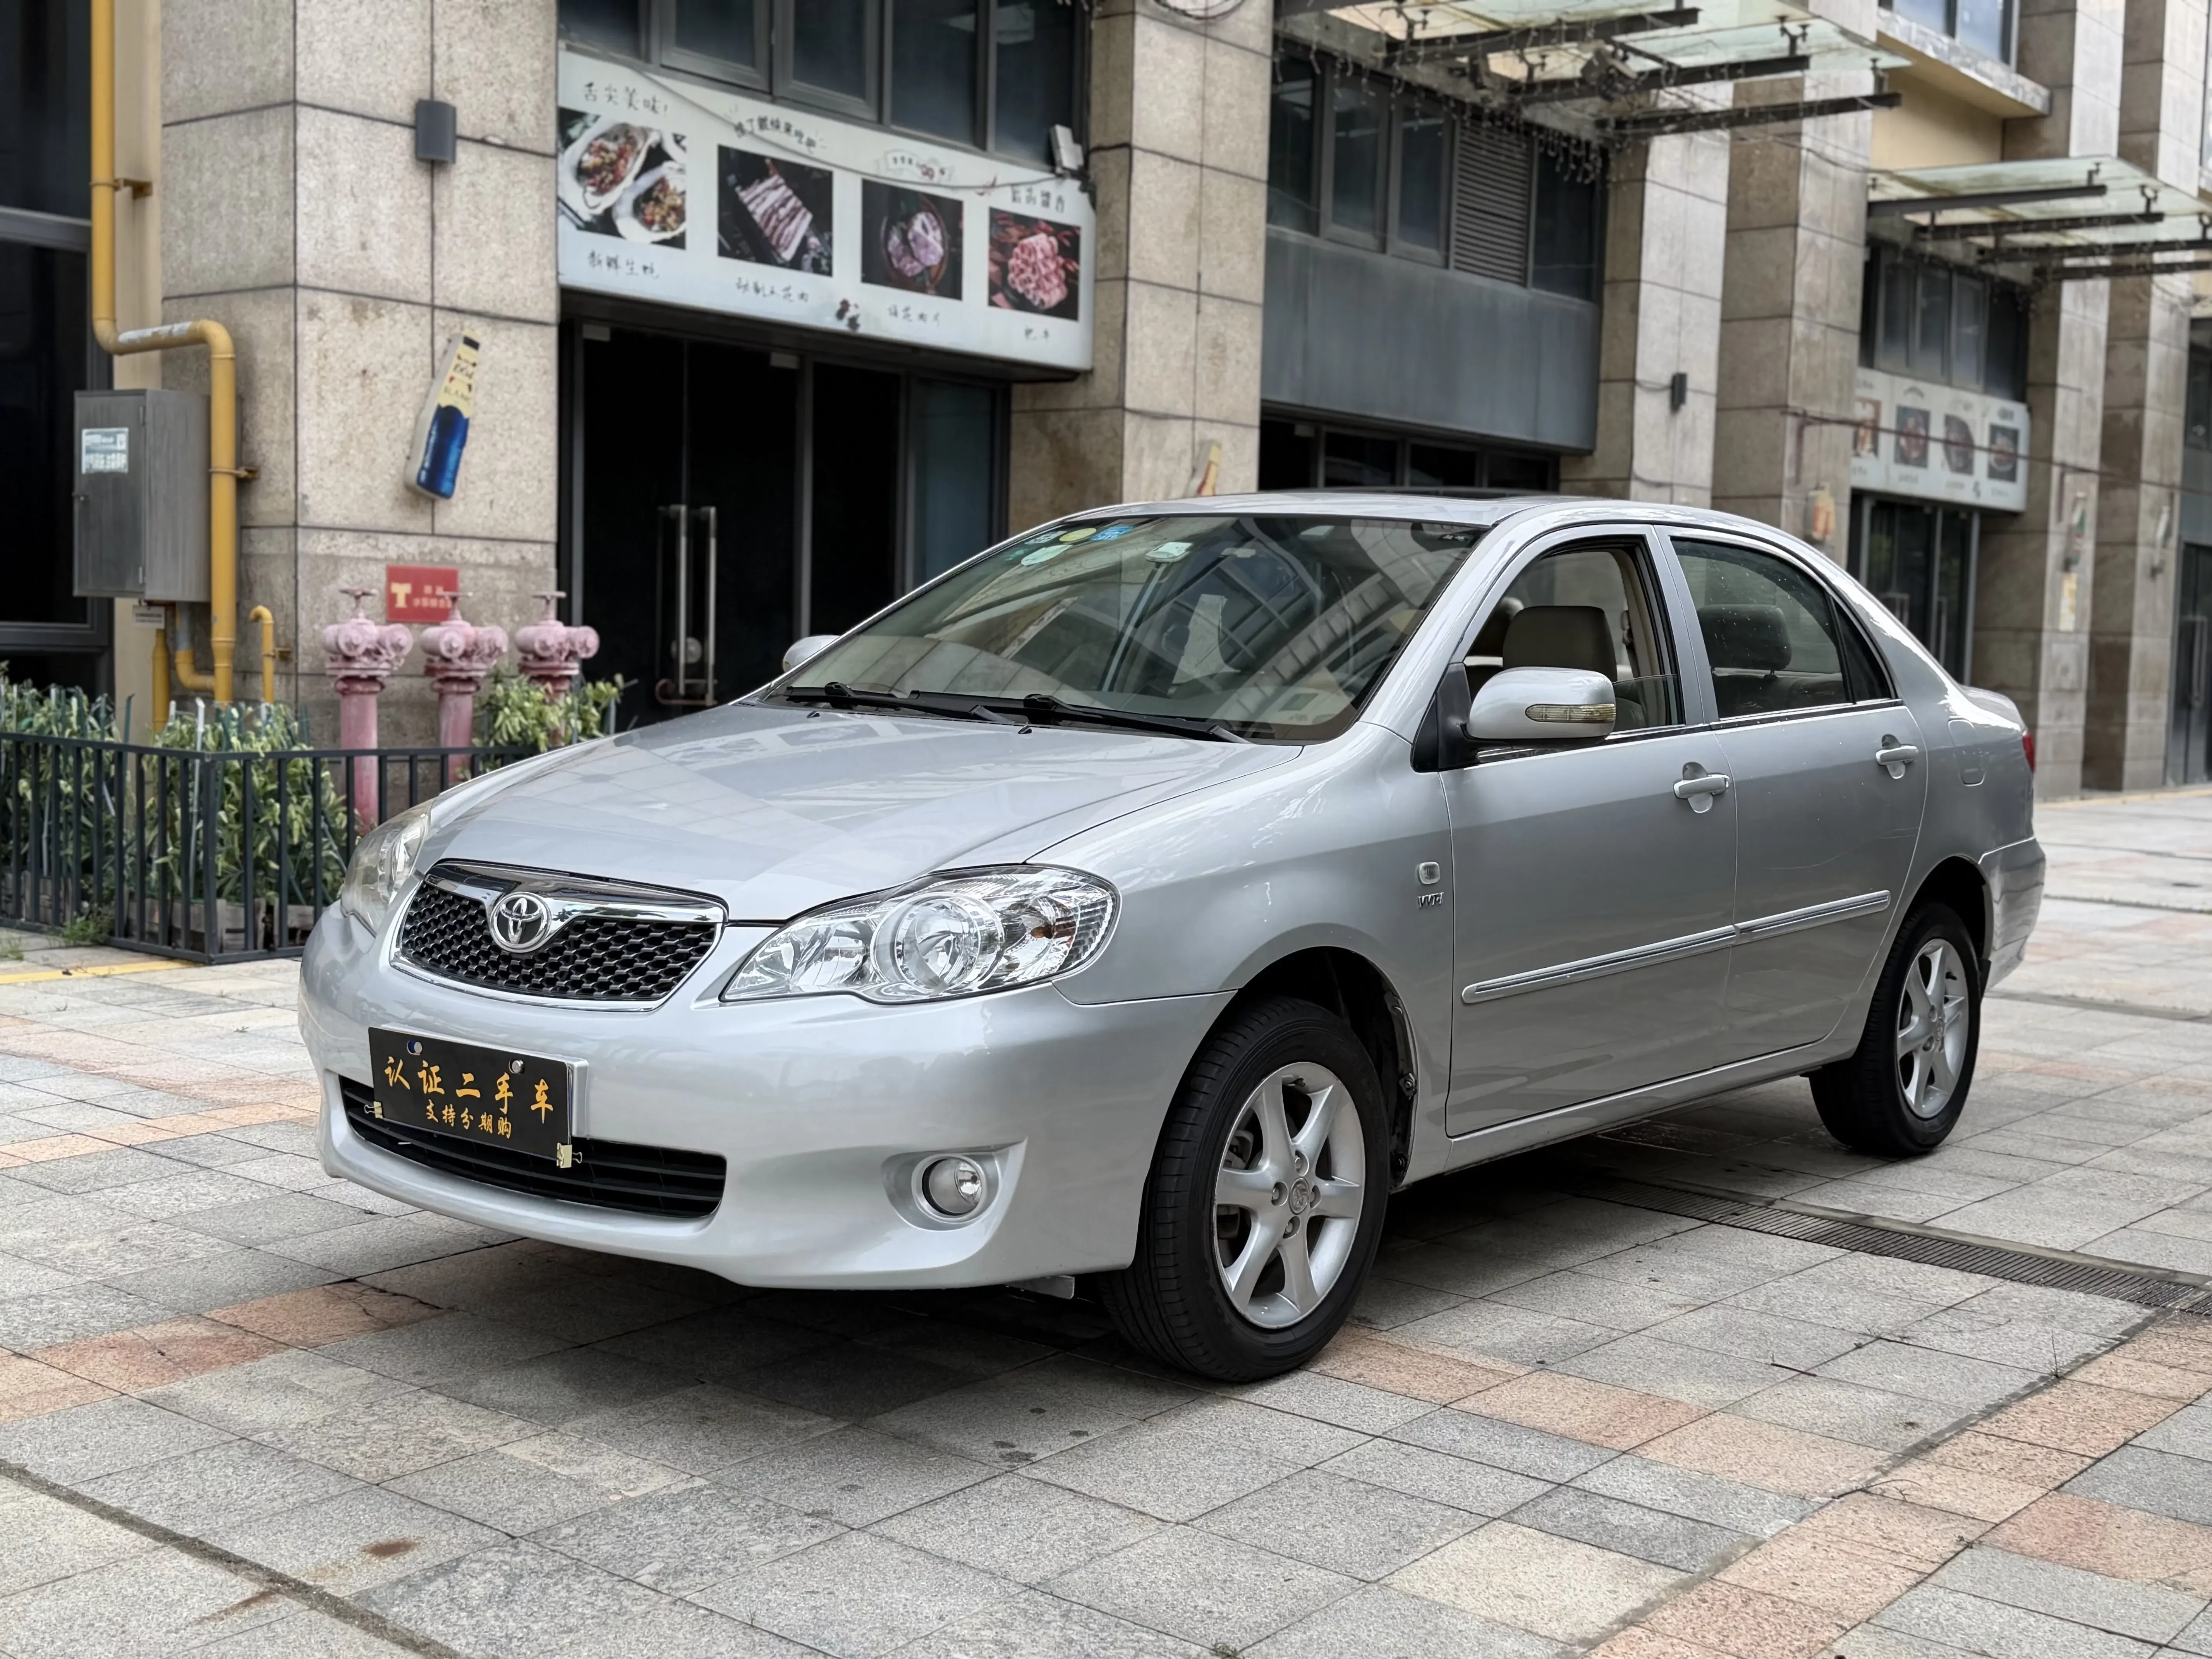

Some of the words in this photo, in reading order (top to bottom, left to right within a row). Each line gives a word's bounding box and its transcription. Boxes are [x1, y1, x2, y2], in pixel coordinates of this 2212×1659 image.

[384, 1056, 554, 1124] 认证二手车
[426, 1099, 512, 1139] 支持分期购
